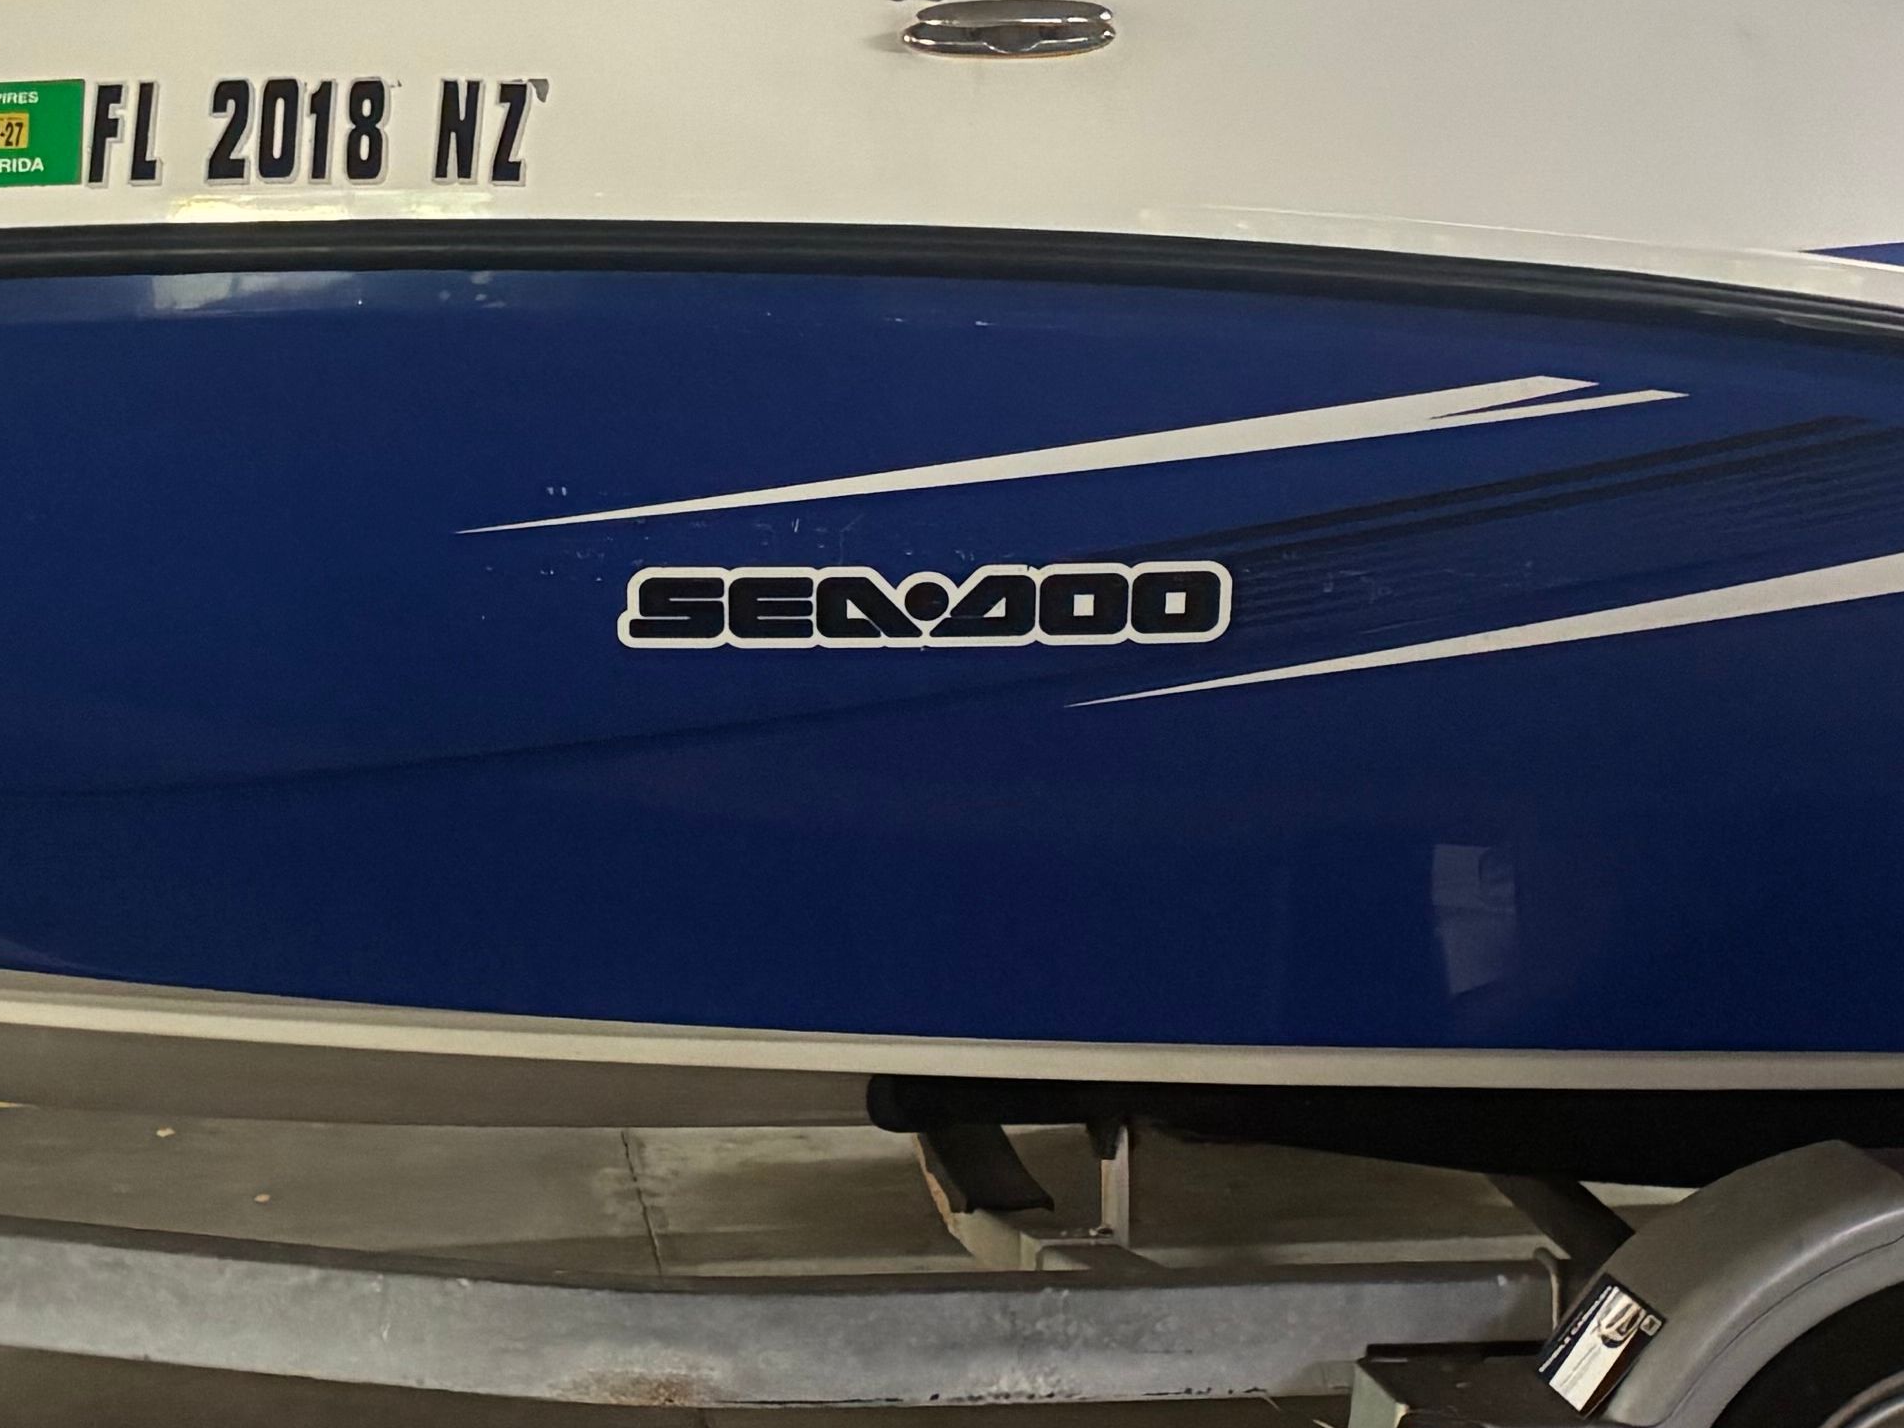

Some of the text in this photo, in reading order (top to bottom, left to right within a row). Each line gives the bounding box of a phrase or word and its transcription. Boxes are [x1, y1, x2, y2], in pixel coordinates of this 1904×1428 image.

[87, 78, 530, 184] FL 2018 NZ
